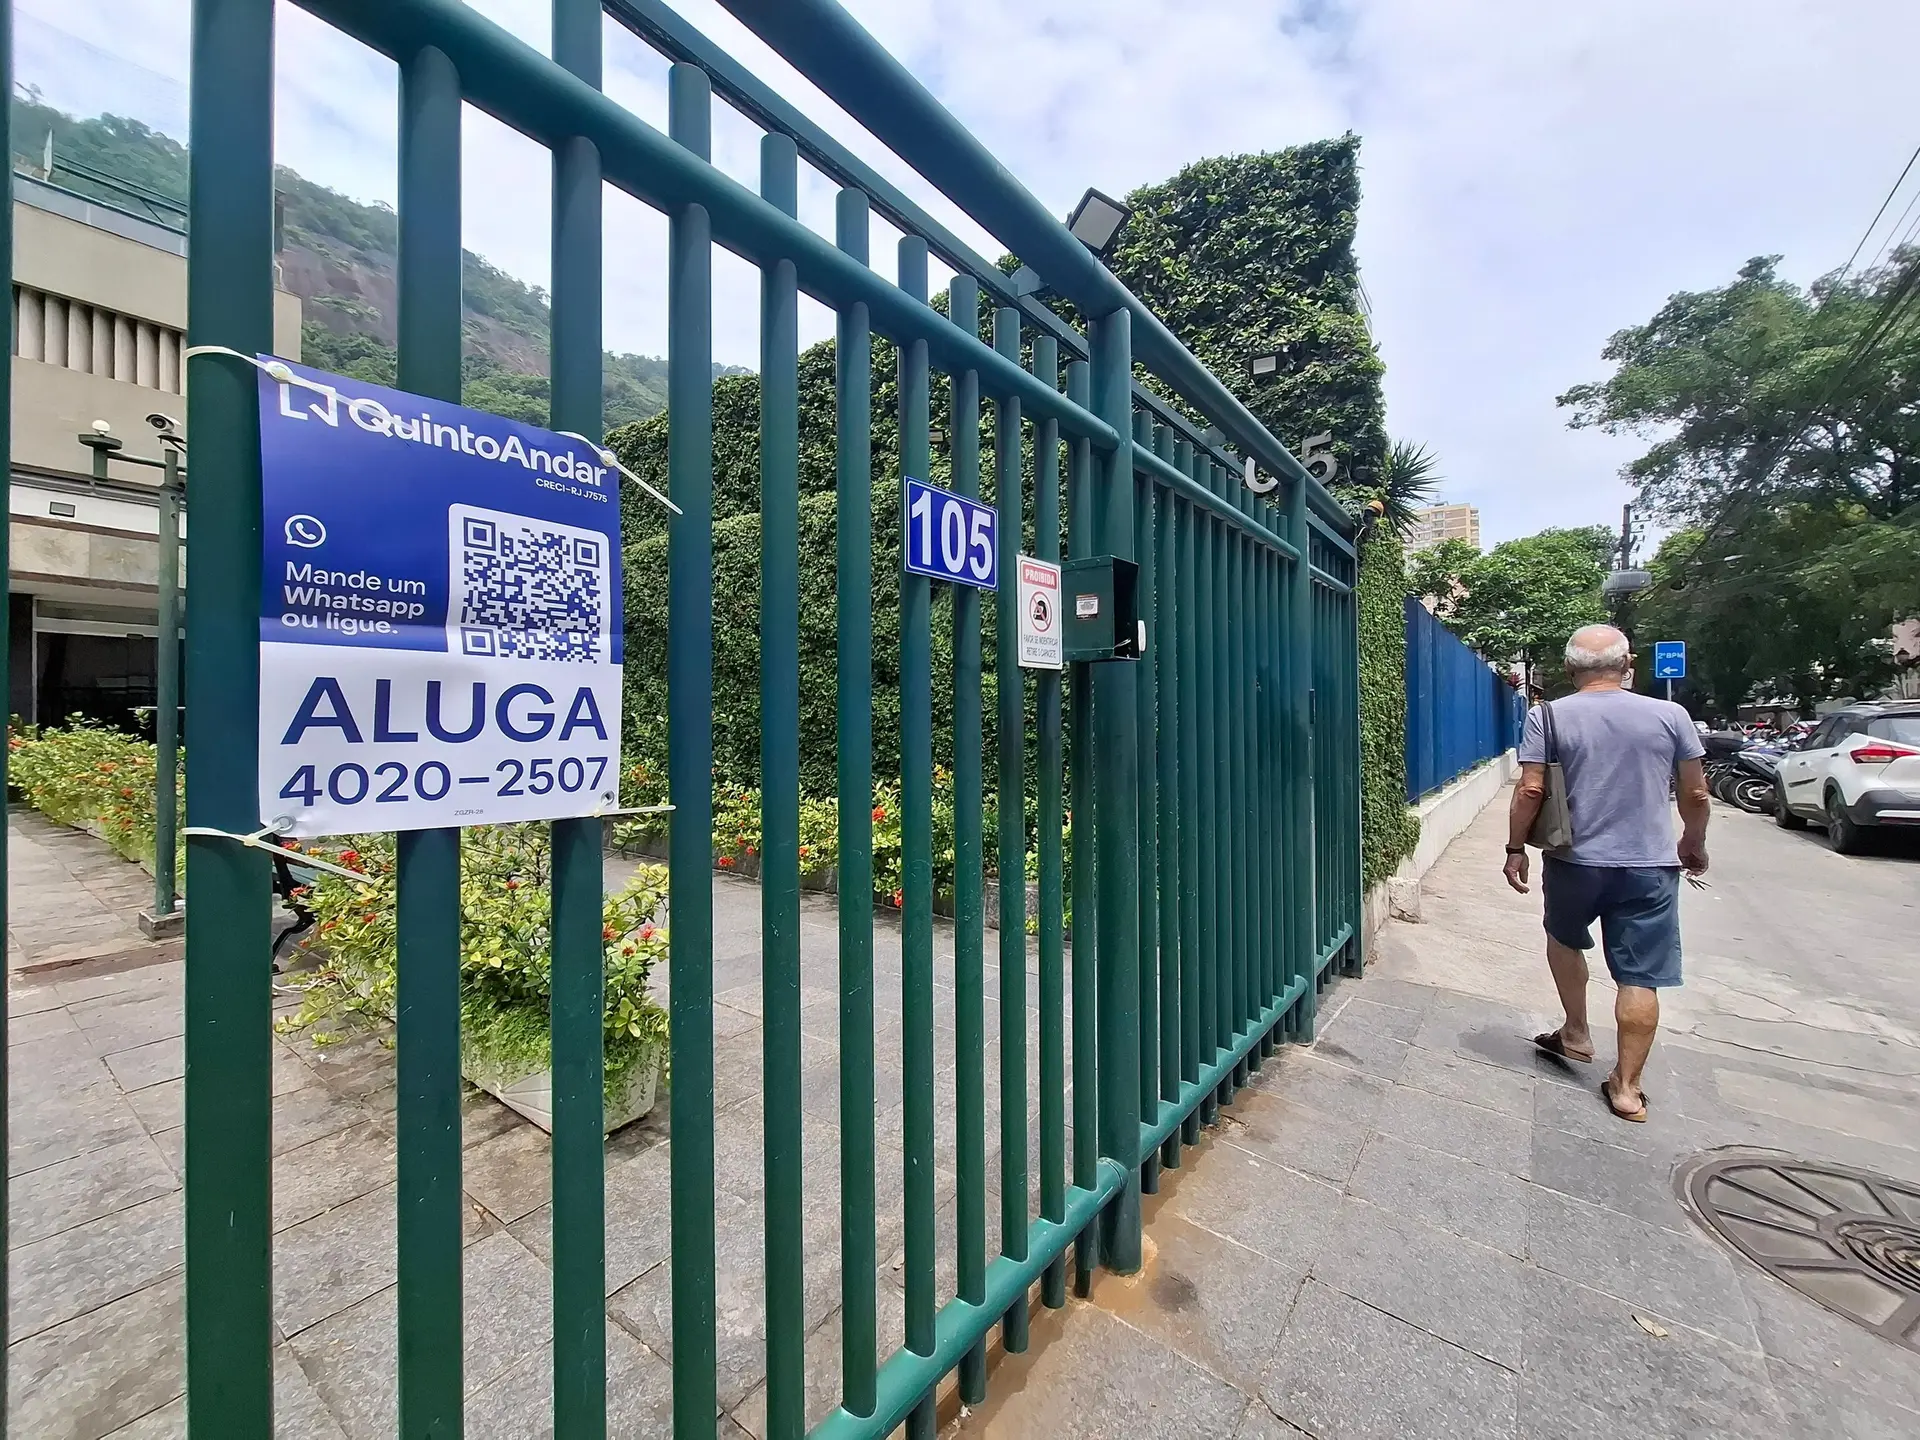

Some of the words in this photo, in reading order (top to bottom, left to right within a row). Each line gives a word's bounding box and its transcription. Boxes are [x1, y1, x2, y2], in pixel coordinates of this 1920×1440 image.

[349, 398, 607, 486] QuintoAndar
[583, 490, 608, 503] J7575
[911, 489, 993, 580] 105
[286, 561, 381, 590] Mande
[388, 578, 426, 596] um
[1025, 568, 1056, 586] PROIBIDA
[284, 585, 425, 619] Whatsapp
[281, 612, 318, 629] ou
[325, 612, 398, 636] ligue.
[280, 676, 609, 745] ALUGA
[279, 756, 609, 807] 4020-2507
